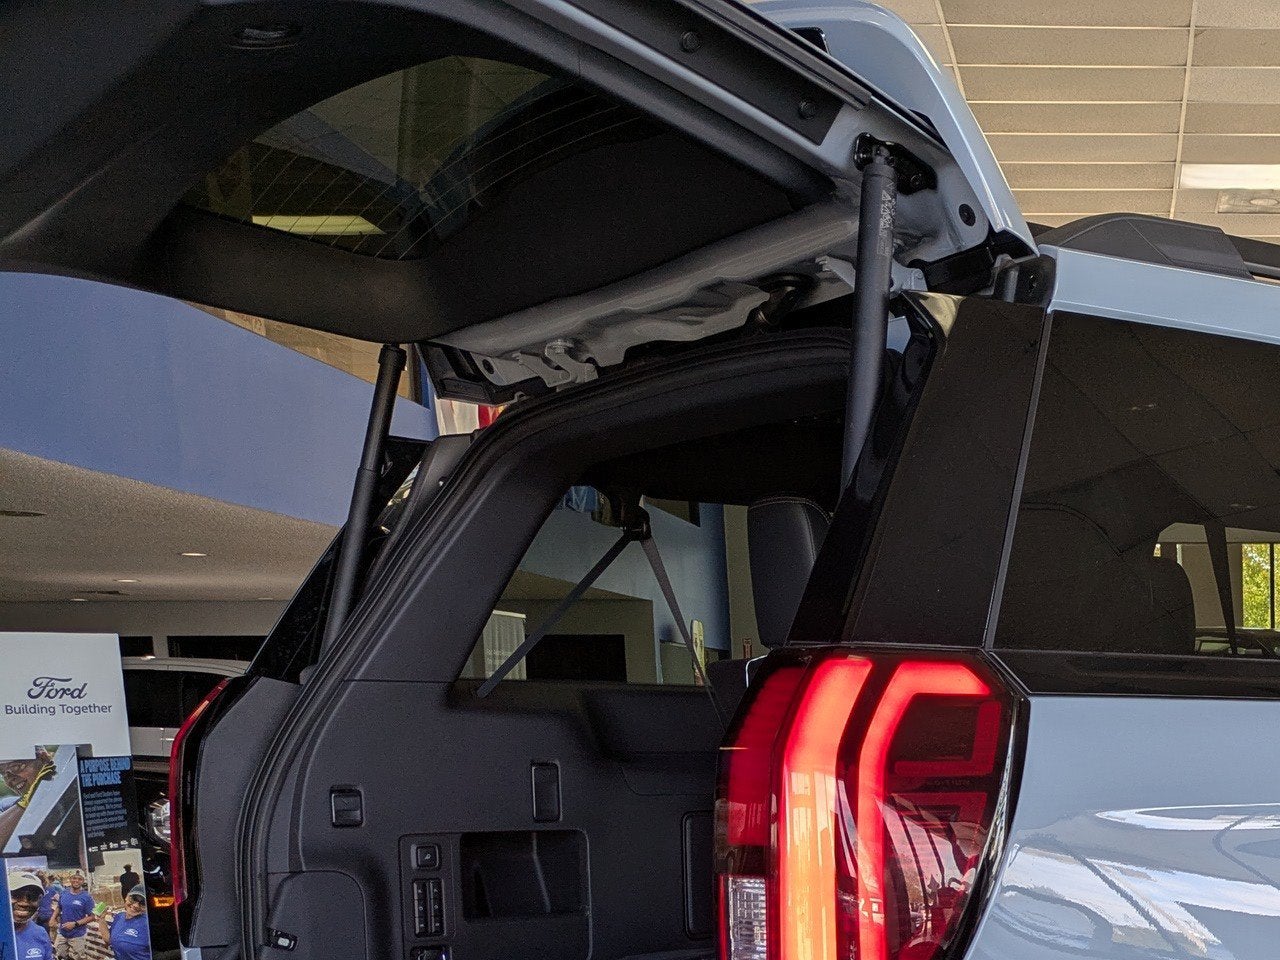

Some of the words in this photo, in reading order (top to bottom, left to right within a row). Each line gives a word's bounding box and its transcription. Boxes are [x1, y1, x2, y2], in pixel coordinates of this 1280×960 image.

[27, 676, 88, 700] Ford
[5, 704, 56, 716] Building
[59, 703, 112, 716] Together
